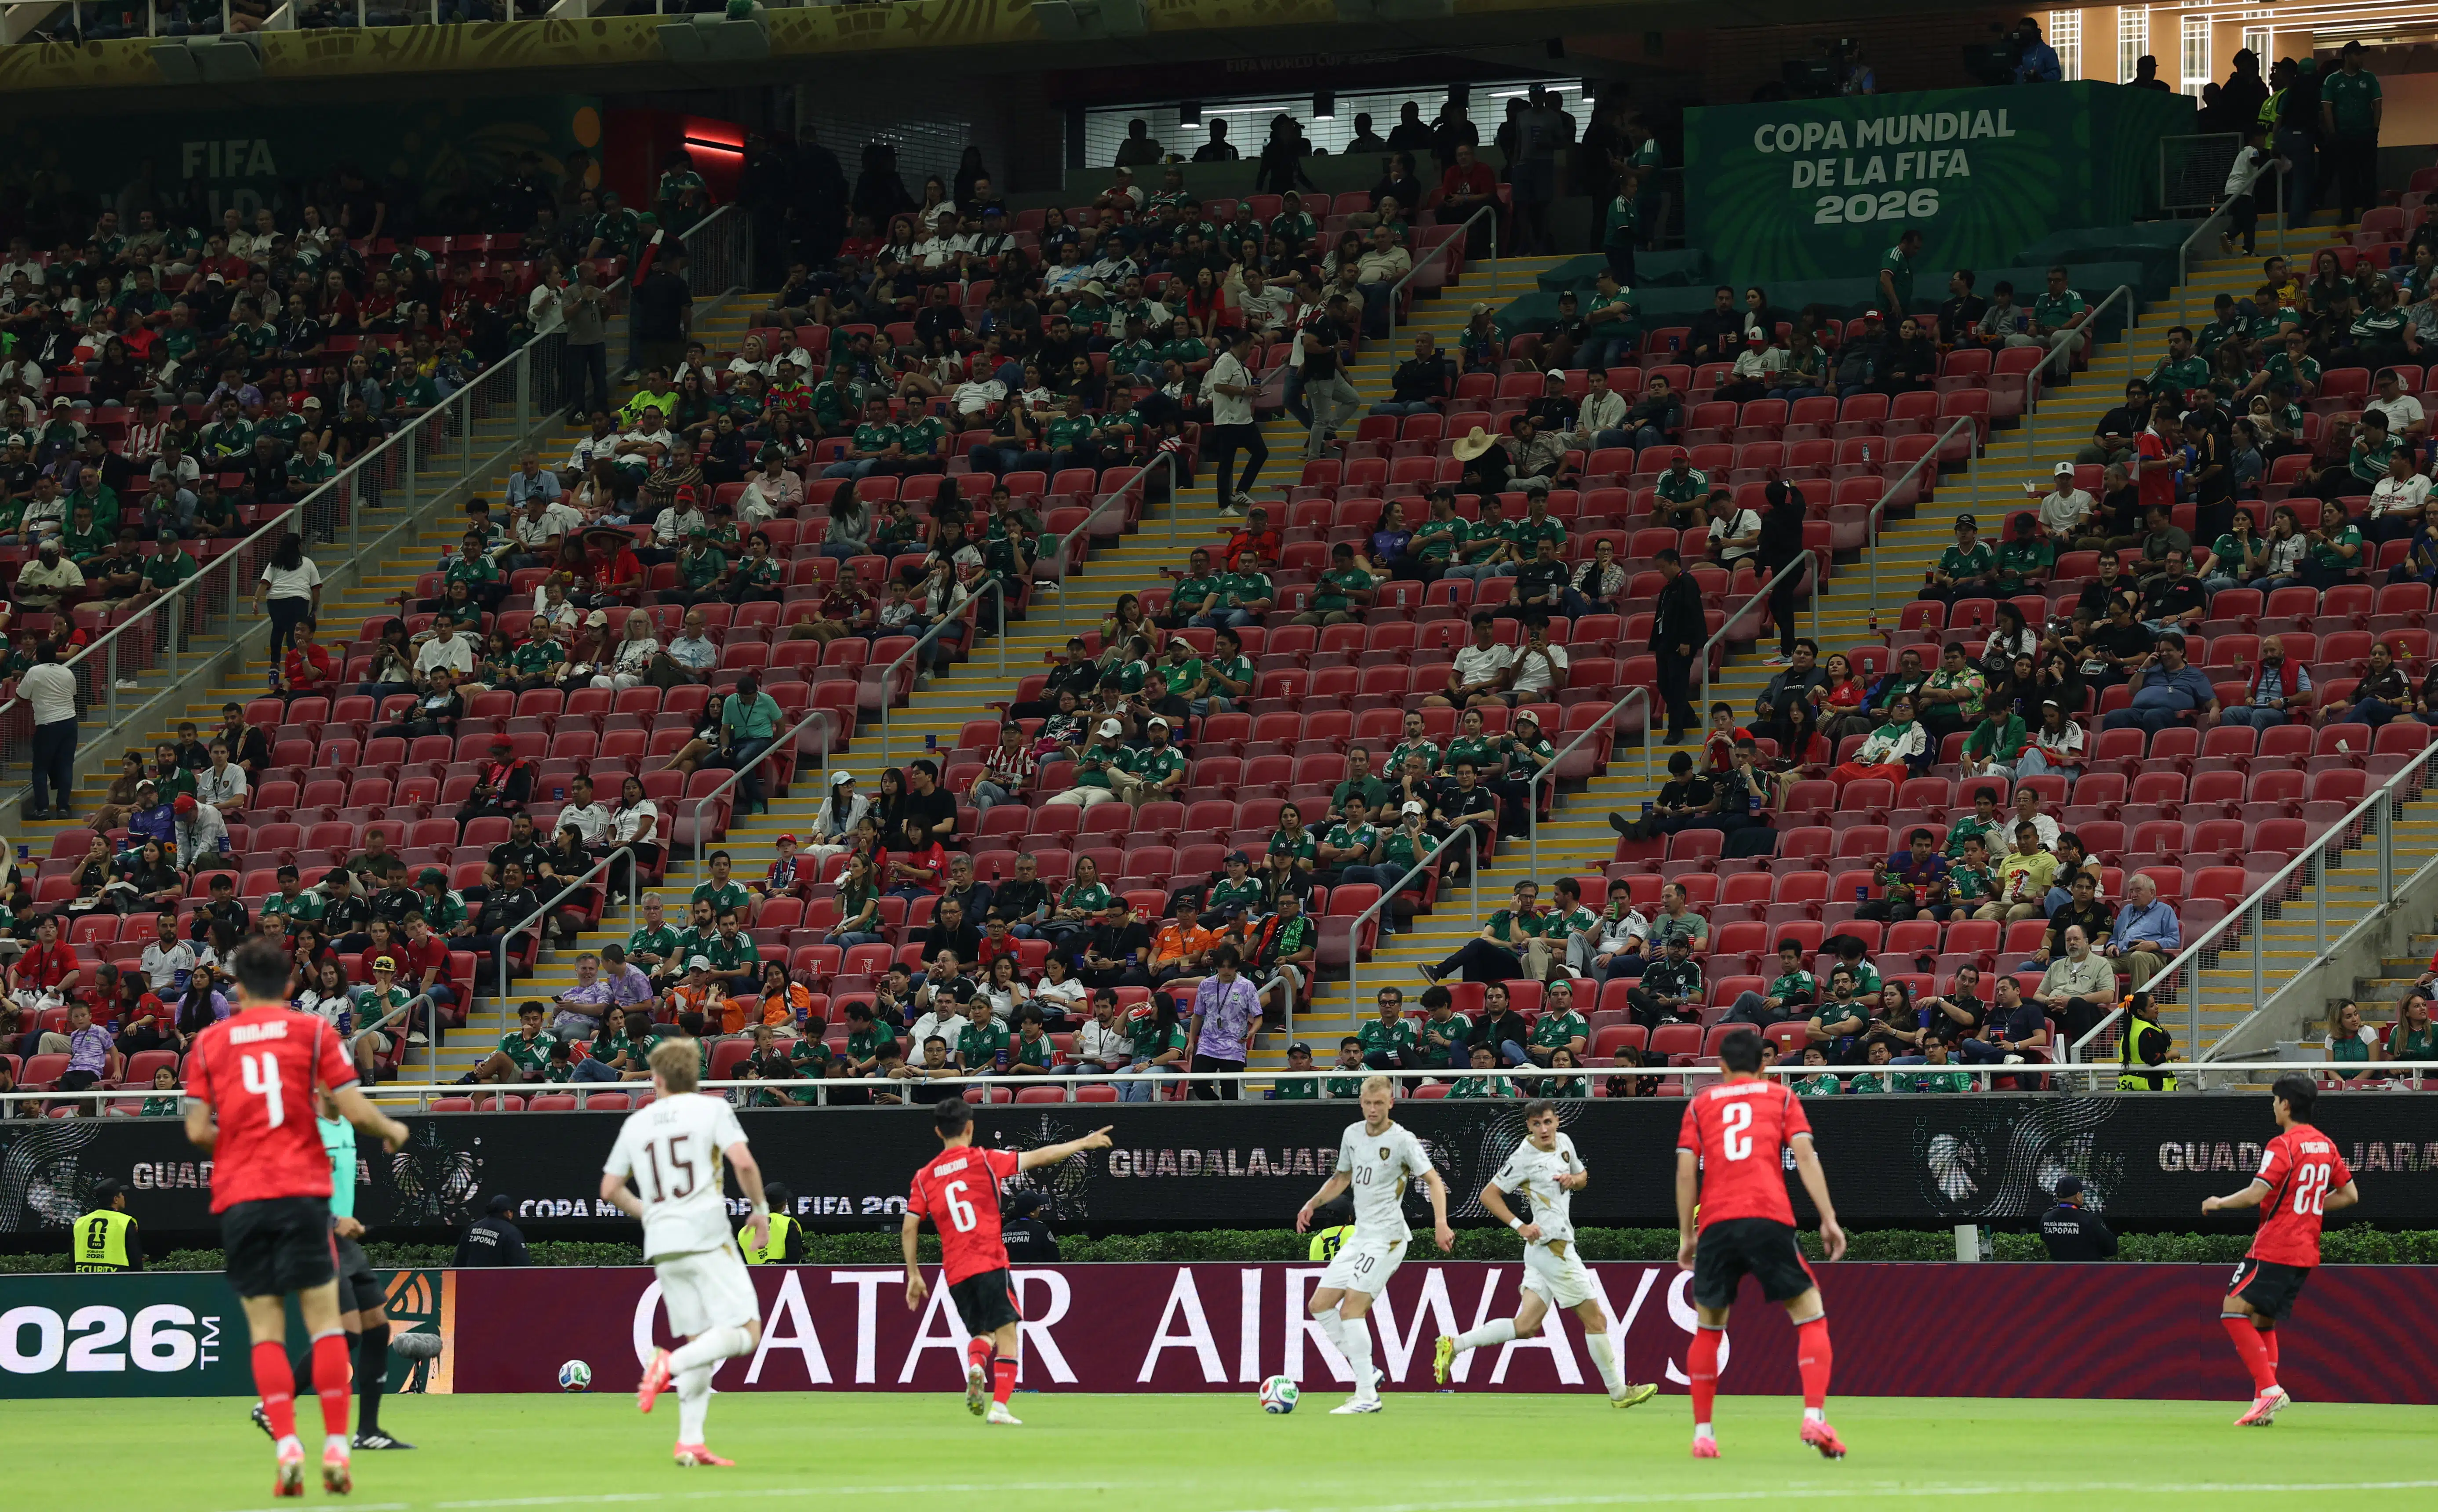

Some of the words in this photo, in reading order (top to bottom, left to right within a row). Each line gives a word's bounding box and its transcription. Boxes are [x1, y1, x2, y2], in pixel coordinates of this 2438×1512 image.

[1754, 121, 1848, 153] COPA
[1856, 109, 2016, 148] MUNDIAL
[182, 138, 277, 179] FIFA
[1792, 158, 1837, 188] DE
[1844, 156, 1887, 185] LA
[1895, 149, 1970, 181] FIFA
[1814, 188, 1939, 224] 2026
[241, 1052, 284, 1129] 4
[1722, 1102, 1753, 1161] 2
[644, 1135, 695, 1203] 15
[1109, 1148, 1339, 1177] GUADALAJAR
[1356, 1166, 1372, 1185] 20
[2158, 1141, 2438, 1172] GUADJARA
[520, 1199, 589, 1217] COPA
[797, 1196, 853, 1214] FIFA
[861, 1196, 908, 1214] 20
[945, 1180, 977, 1233] 6
[2292, 1163, 2330, 1215] 22
[469, 1235, 497, 1247] ZAPOPAN
[1354, 1253, 1375, 1273] 20
[0, 1304, 197, 1374] 026
[200, 1316, 221, 1370] TM
